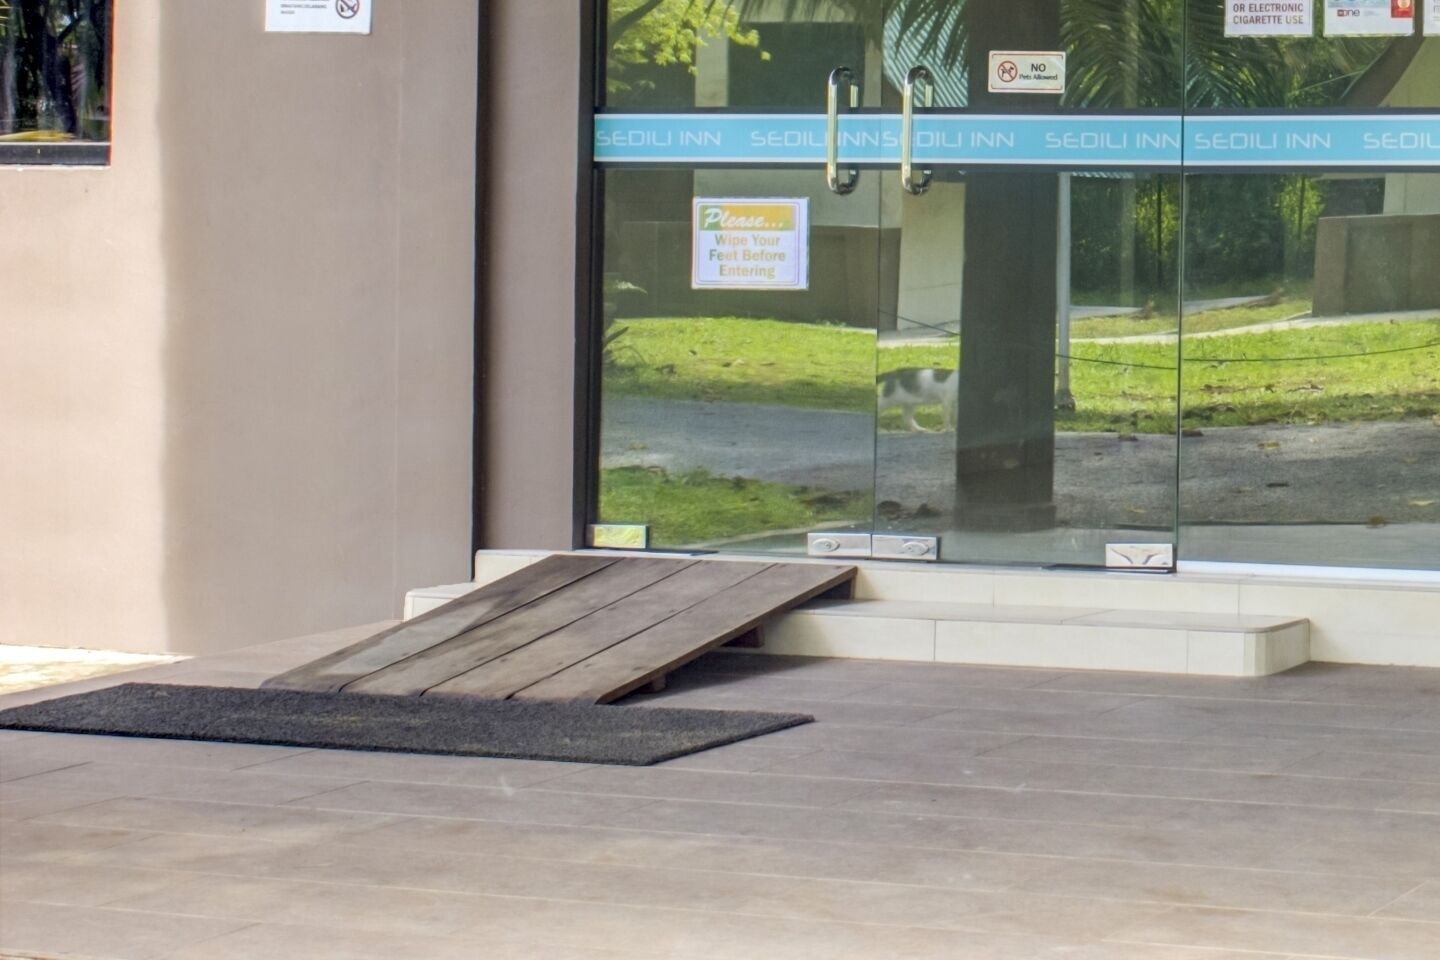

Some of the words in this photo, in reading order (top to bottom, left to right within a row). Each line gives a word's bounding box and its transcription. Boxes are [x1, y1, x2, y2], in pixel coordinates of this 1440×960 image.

[1232, 3, 1246, 13] OR
[1248, 3, 1304, 13] ELECTRONIC
[1232, 15, 1283, 25] CIGARETTE
[1285, 15, 1304, 25] USE
[1030, 63, 1046, 72] NO
[596, 130, 671, 147] SEDILI
[680, 130, 721, 147] INN
[971, 131, 1015, 148] INN
[1045, 131, 1127, 149] SEDILI
[1136, 131, 1180, 149] INN
[1194, 131, 1277, 150] SEDILI
[1286, 131, 1332, 150] INN
[714, 233, 748, 247] Wipe
[752, 233, 781, 247] Your
[709, 248, 739, 261] Feet
[742, 248, 787, 261] Before
[719, 264, 776, 280] Entering
